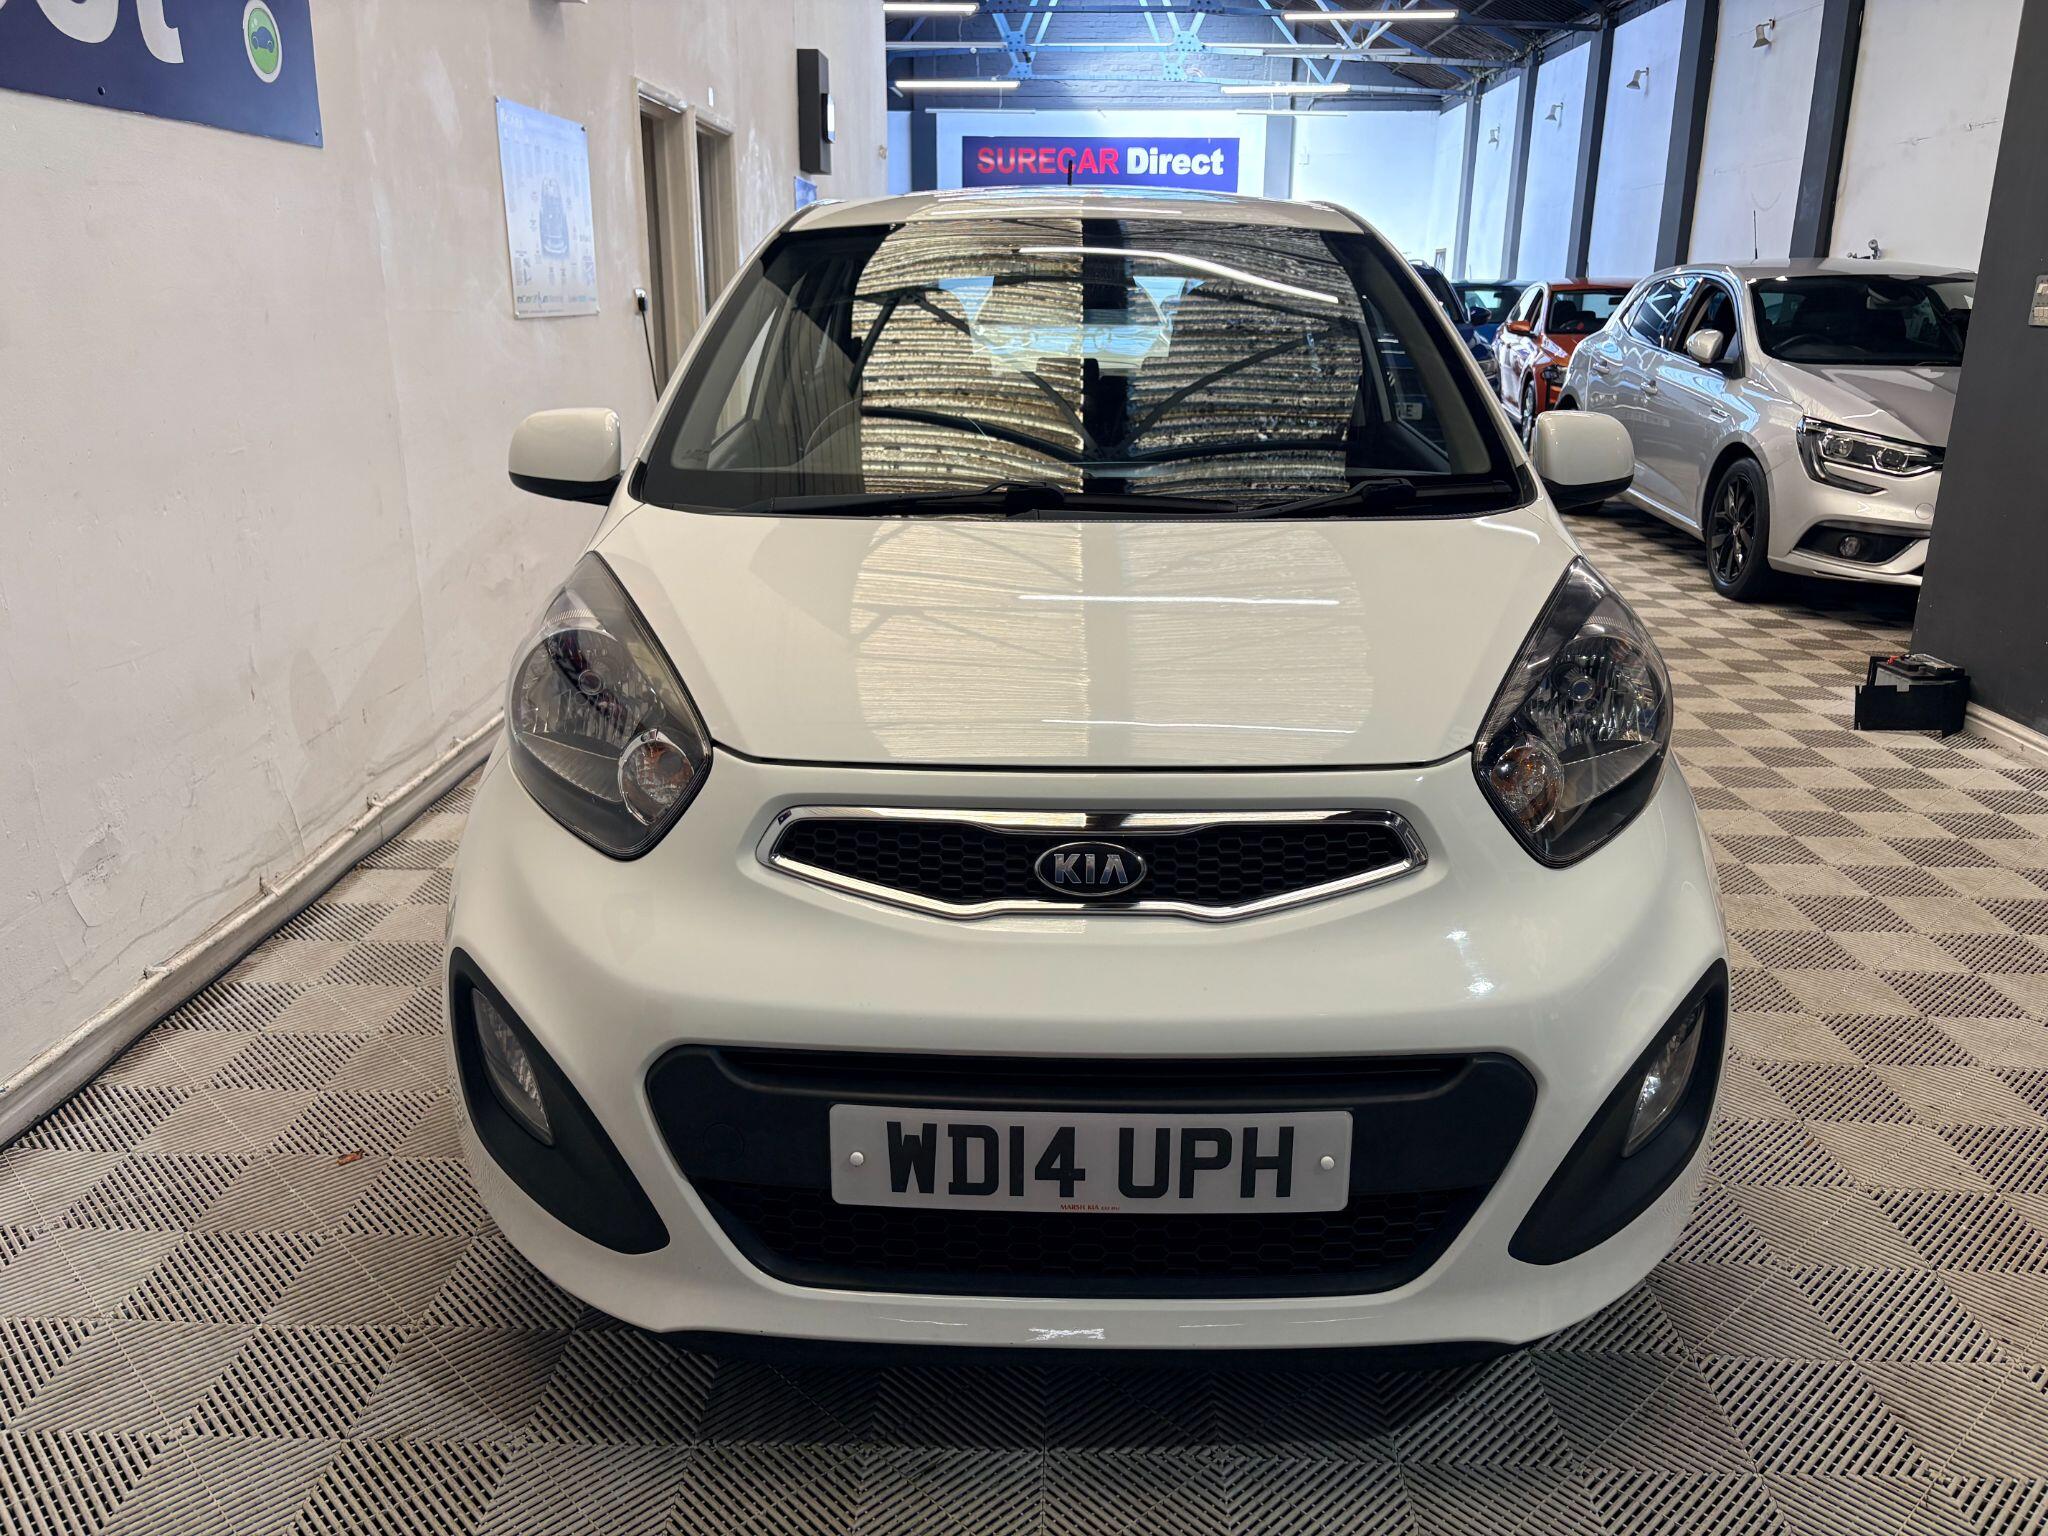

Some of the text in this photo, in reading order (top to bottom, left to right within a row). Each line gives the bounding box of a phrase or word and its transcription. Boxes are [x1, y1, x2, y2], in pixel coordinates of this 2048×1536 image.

[977, 147, 1225, 175] SURECAR Direct
[1054, 853, 1129, 884] KIA
[886, 1121, 1295, 1199] WD14 UPH
